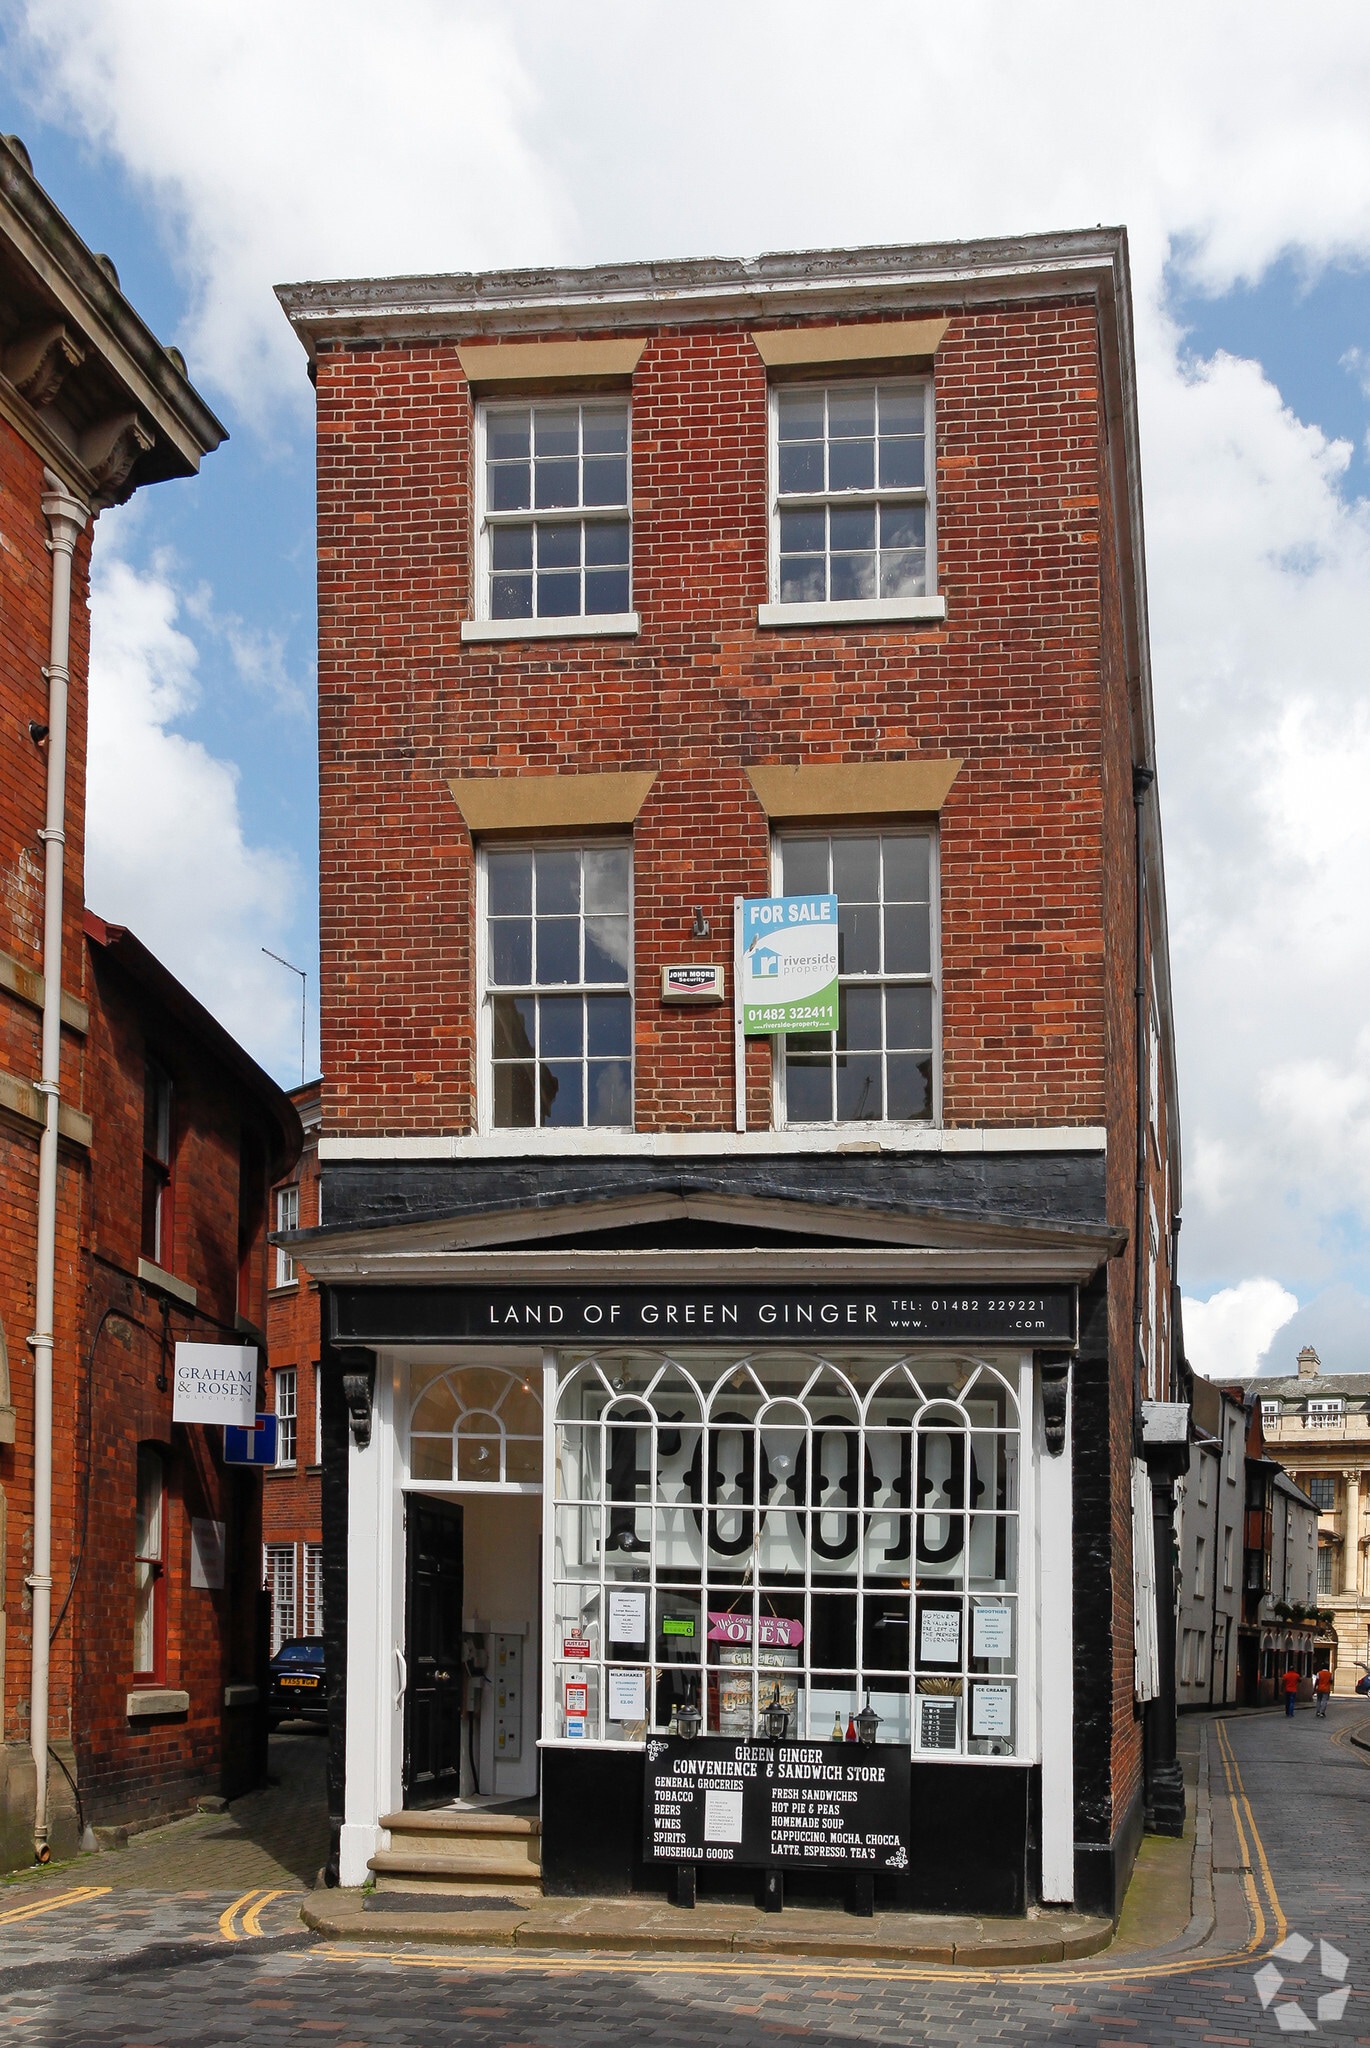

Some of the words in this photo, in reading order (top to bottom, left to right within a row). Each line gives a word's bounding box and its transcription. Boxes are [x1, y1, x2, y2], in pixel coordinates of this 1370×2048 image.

[751, 905, 783, 924] FOR
[788, 902, 831, 921] SALE
[783, 954, 836, 966] riverside
[783, 964, 837, 976] property
[748, 1008, 785, 1021] 01482
[789, 1006, 833, 1019] 322411
[891, 1300, 923, 1311] TEL:
[931, 1300, 979, 1311] 01482
[988, 1300, 1045, 1311] 229221
[489, 1304, 564, 1323] LAND
[583, 1304, 621, 1323] OF
[640, 1304, 738, 1323] GREEN
[758, 1304, 878, 1323] GINGER
[890, 1320, 928, 1328] www.
[1008, 1318, 1046, 1329] .com
[178, 1367, 251, 1382] GRAHAM
[177, 1381, 191, 1393] &
[197, 1382, 252, 1396] ROSEN
[735, 1746, 774, 1762] GREEN
[779, 1748, 823, 1764] GINGER
[673, 1760, 757, 1777] CONVENIENCE
[766, 1763, 774, 1777] &
[778, 1764, 842, 1781] SANDWICH
[846, 1767, 885, 1782] STORE
[655, 1776, 695, 1789] GENERAL
[697, 1778, 744, 1791] GROCERIES
[654, 1790, 693, 1802] TOBACCO
[771, 1788, 799, 1800] FRESH
[801, 1789, 858, 1802] SANDWICHES
[654, 1804, 681, 1816] BEERS
[771, 1802, 789, 1814] HOT
[791, 1802, 806, 1814] PIE
[808, 1803, 814, 1814] &
[817, 1803, 840, 1815] PEAS
[654, 1818, 681, 1829] WINES
[771, 1816, 820, 1829] HOMEMADE
[822, 1817, 844, 1830] SOUP
[653, 1832, 686, 1844] SPIRITS
[866, 1833, 900, 1846] CHOCCA
[653, 1846, 703, 1858] HOUSEHOLD
[706, 1847, 734, 1860] GOODS
[850, 1847, 876, 1859] TEA'S
